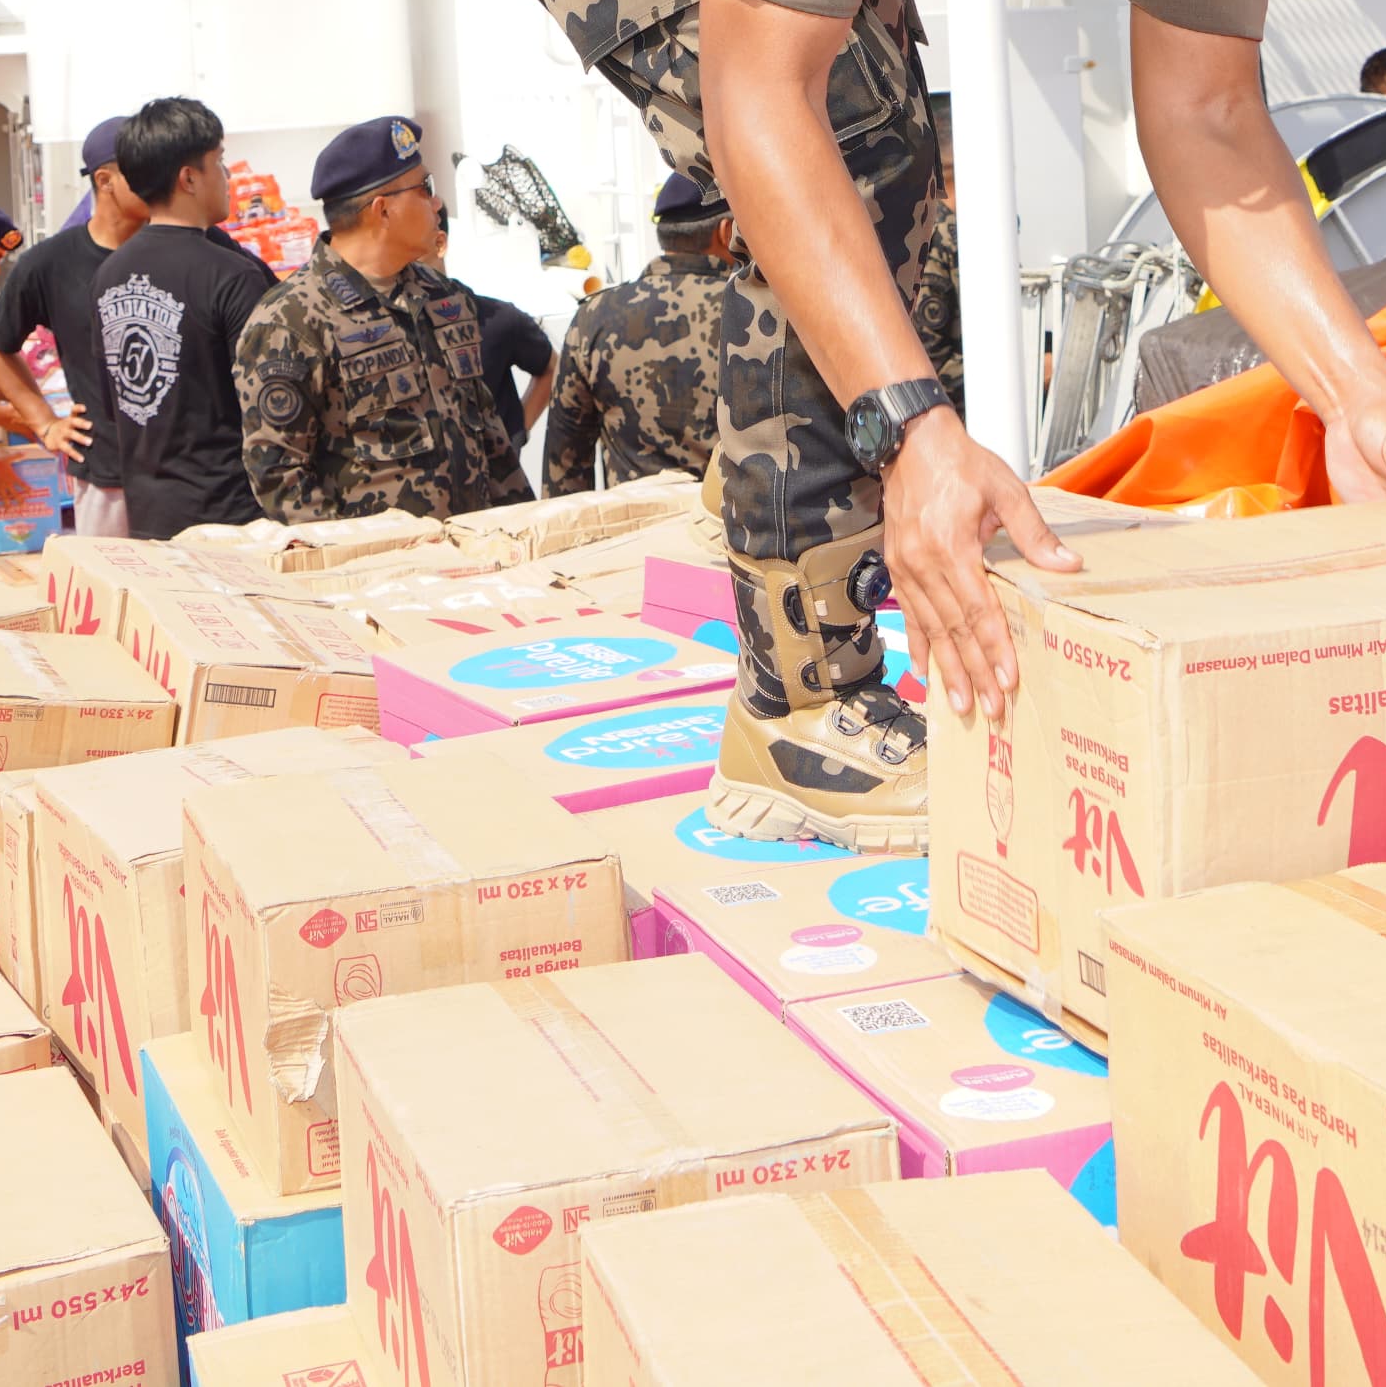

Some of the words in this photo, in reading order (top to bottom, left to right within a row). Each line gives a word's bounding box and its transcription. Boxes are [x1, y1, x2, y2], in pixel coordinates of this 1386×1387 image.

[442, 325, 477, 345] KKP
[342, 347, 408, 377] TOPANDI
[1043, 629, 1058, 651] ml
[1315, 642, 1363, 661] Minum
[1063, 639, 1093, 669] 550
[1185, 652, 1258, 677] Kemasan
[1261, 648, 1311, 668] Dalam
[1106, 657, 1133, 682] 24
[79, 707, 96, 719] ml
[99, 707, 124, 721] 330
[137, 708, 154, 721] 24
[559, 731, 689, 760] Pure
[1060, 727, 1130, 773] Berkualitas
[1065, 754, 1088, 780] Pas
[1090, 764, 1126, 799] Harga
[1062, 788, 1145, 899] Vit
[507, 879, 545, 899] 330
[563, 872, 588, 892] 24
[477, 885, 501, 905] ml
[383, 913, 411, 925] HALAL
[499, 939, 583, 963] Berkualitas
[1109, 939, 1148, 975] Kemasan
[505, 964, 532, 980] Pas
[535, 956, 579, 975] Harga
[1148, 963, 1177, 994] Dalam
[1178, 981, 1212, 1013] Minum
[1213, 1002, 1227, 1022] Air
[1203, 1031, 1279, 1096] Berkualitas
[1237, 1081, 1295, 1130] MINERAL
[1281, 1081, 1308, 1117] Pas
[1297, 1123, 1319, 1148] AIR
[1312, 1102, 1359, 1150] Harga
[752, 1158, 798, 1187] 330
[821, 1148, 852, 1174] 24
[716, 1168, 745, 1192] ml
[121, 1275, 150, 1298] 24
[12, 1302, 44, 1331] ml
[50, 1290, 98, 1318] 550
[44, 1359, 146, 1387] Berkualit
